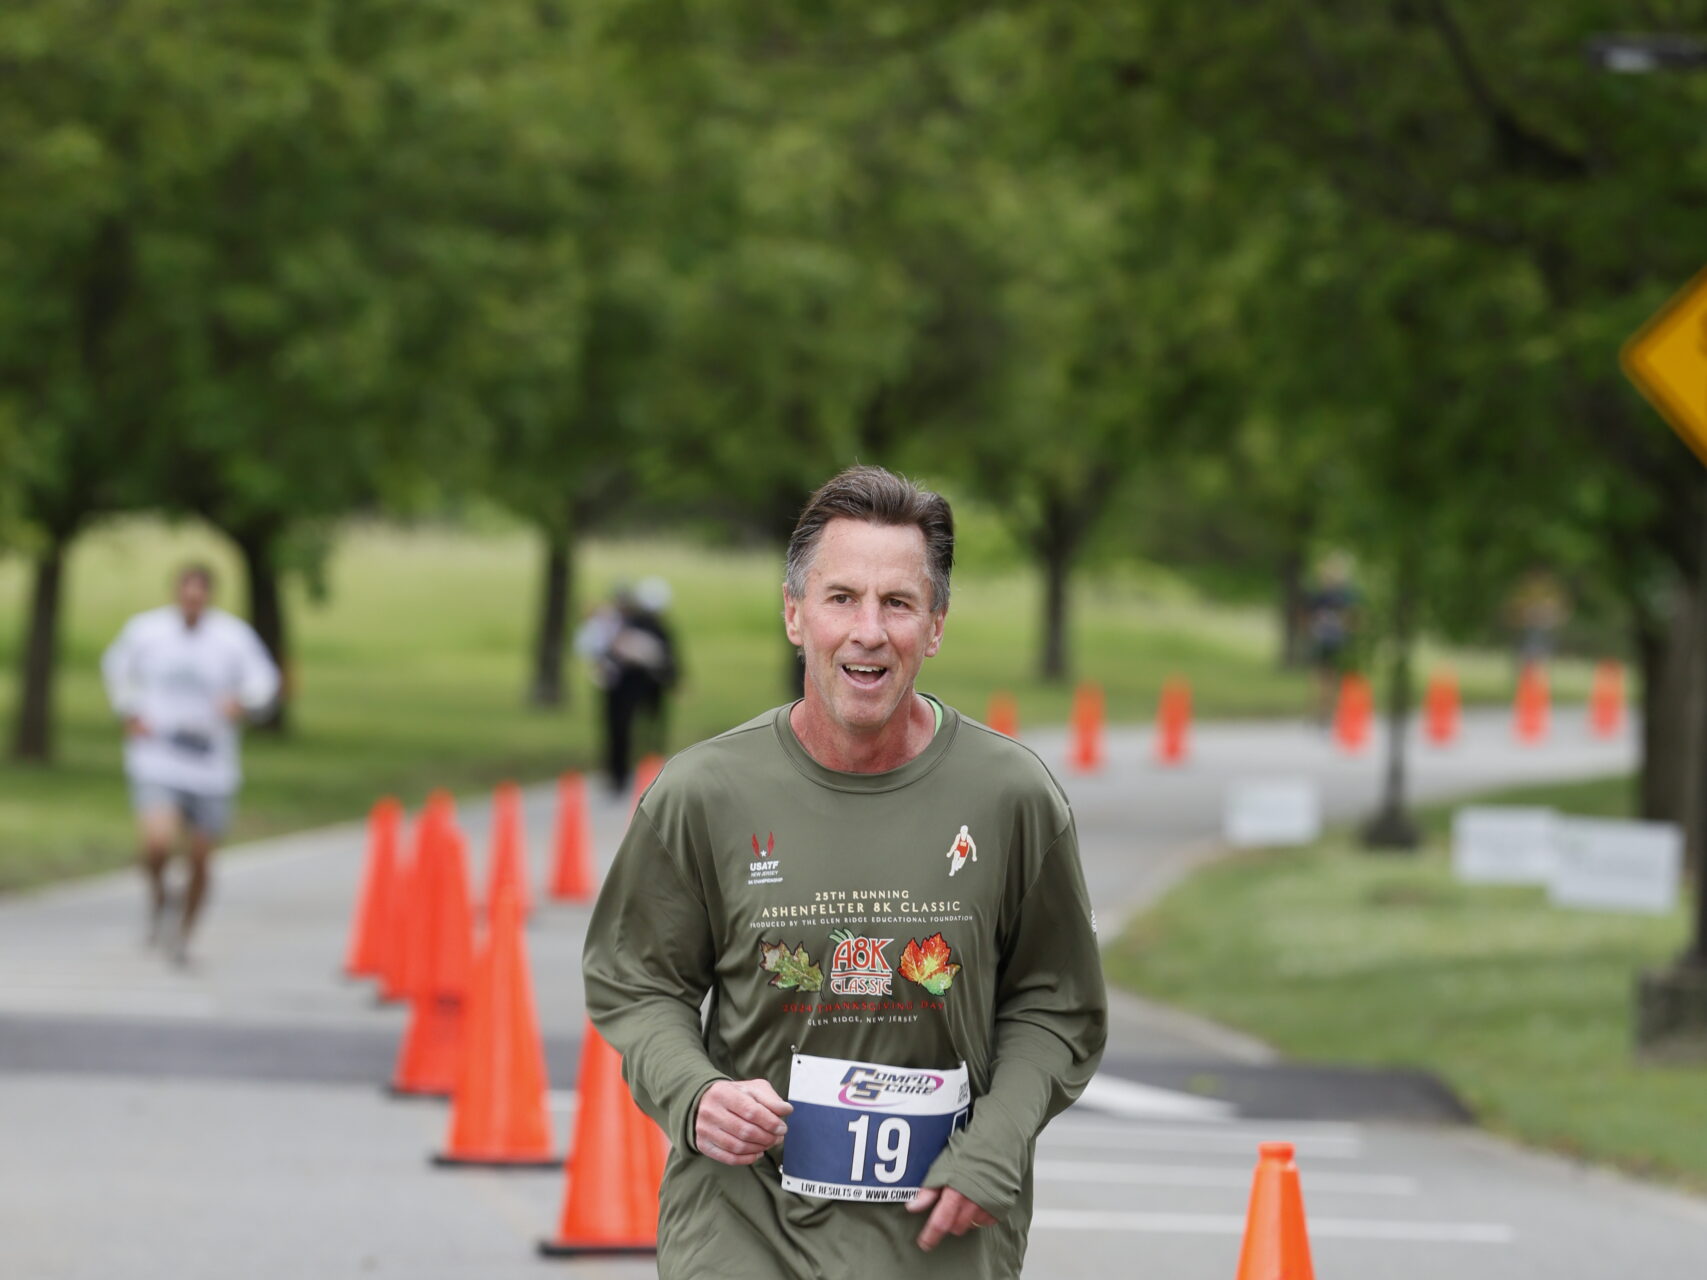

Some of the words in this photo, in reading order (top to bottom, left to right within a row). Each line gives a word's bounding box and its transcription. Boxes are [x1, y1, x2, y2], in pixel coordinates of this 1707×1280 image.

[750, 861, 779, 871] USATF
[815, 891, 846, 901] 25TH
[853, 889, 910, 900] RUNNING
[762, 903, 865, 918] ASHENFELTER
[873, 902, 892, 913] 8K
[901, 901, 961, 913] CLASSIC
[750, 920, 786, 929] PRODUCED
[802, 918, 816, 926] THE
[820, 917, 841, 925] GLEN
[930, 914, 973, 922] FOUNDATION
[832, 936, 895, 972] A8K
[831, 977, 893, 996] CLASSIC
[817, 1001, 914, 1013] THANKSGIVING
[920, 1000, 945, 1010] DAY
[807, 1018, 829, 1026] GLEN
[832, 1015, 863, 1024] RIDGE,
[866, 1015, 885, 1023] NEW
[888, 1013, 919, 1023] JERSEY
[847, 1114, 911, 1184] 19
[801, 1182, 817, 1194] LIVE
[818, 1186, 852, 1198] RESULTS
[853, 1189, 863, 1198] @
